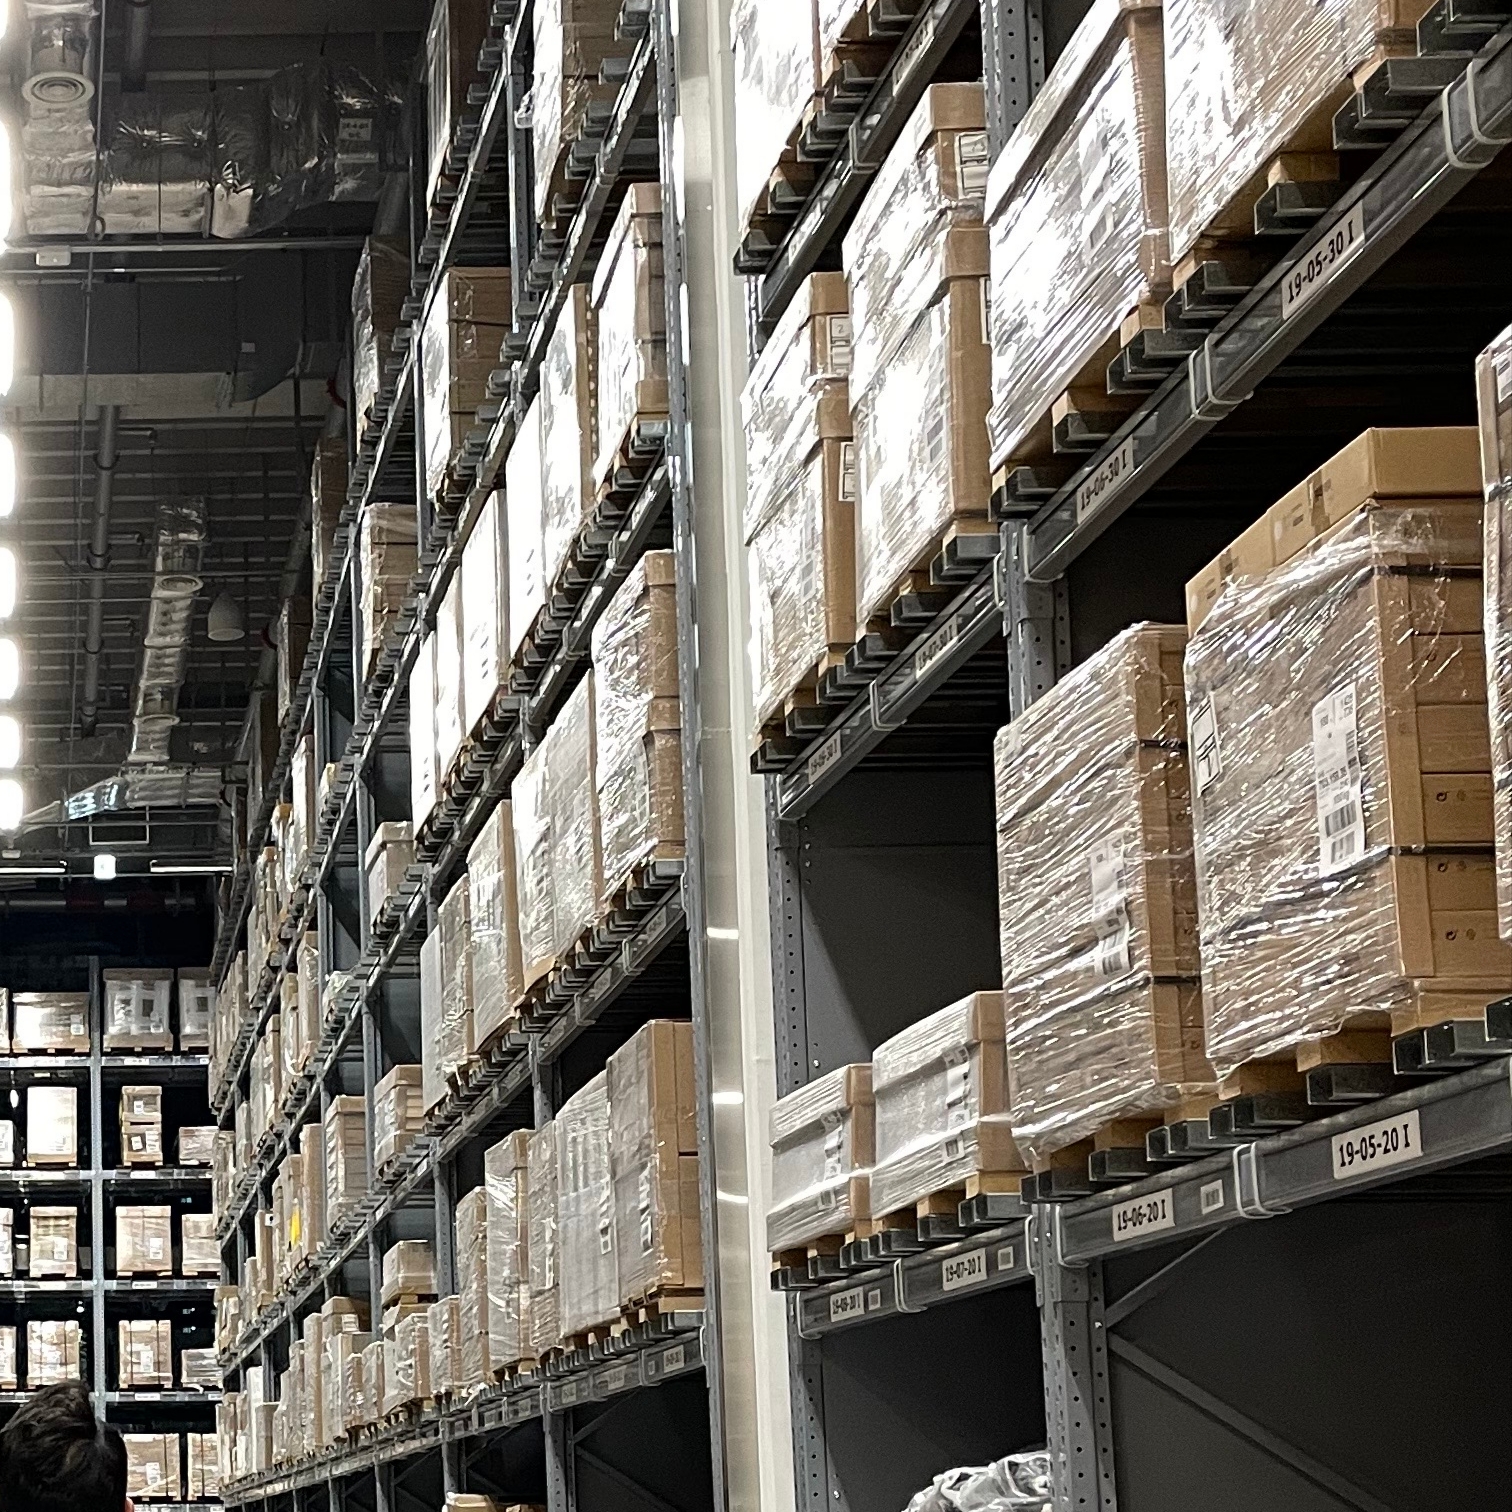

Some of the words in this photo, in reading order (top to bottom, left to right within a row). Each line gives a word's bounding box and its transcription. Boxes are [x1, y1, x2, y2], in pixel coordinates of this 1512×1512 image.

[1288, 230, 1344, 304] 19-05-30
[1080, 456, 1120, 511] 19-06-30
[1339, 1127, 1399, 1168] 19-05-20
[1117, 1201, 1159, 1232] 19-06-20
